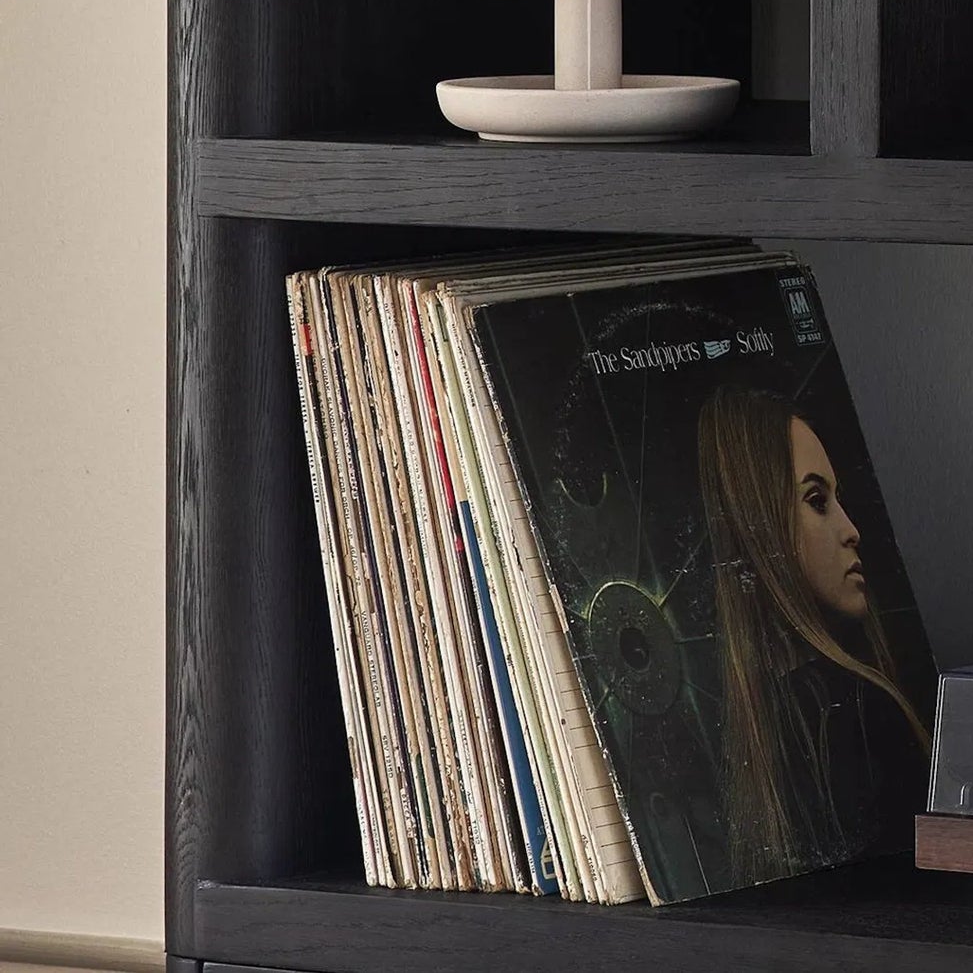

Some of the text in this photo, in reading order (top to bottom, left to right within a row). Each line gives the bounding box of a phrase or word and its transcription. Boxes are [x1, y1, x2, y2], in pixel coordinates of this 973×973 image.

[779, 277, 806, 287] STEREO
[588, 327, 775, 374] The Sandpipers Softly
[338, 476, 346, 493] FOR
[361, 610, 381, 707] VANGUARD STEREOLAB
